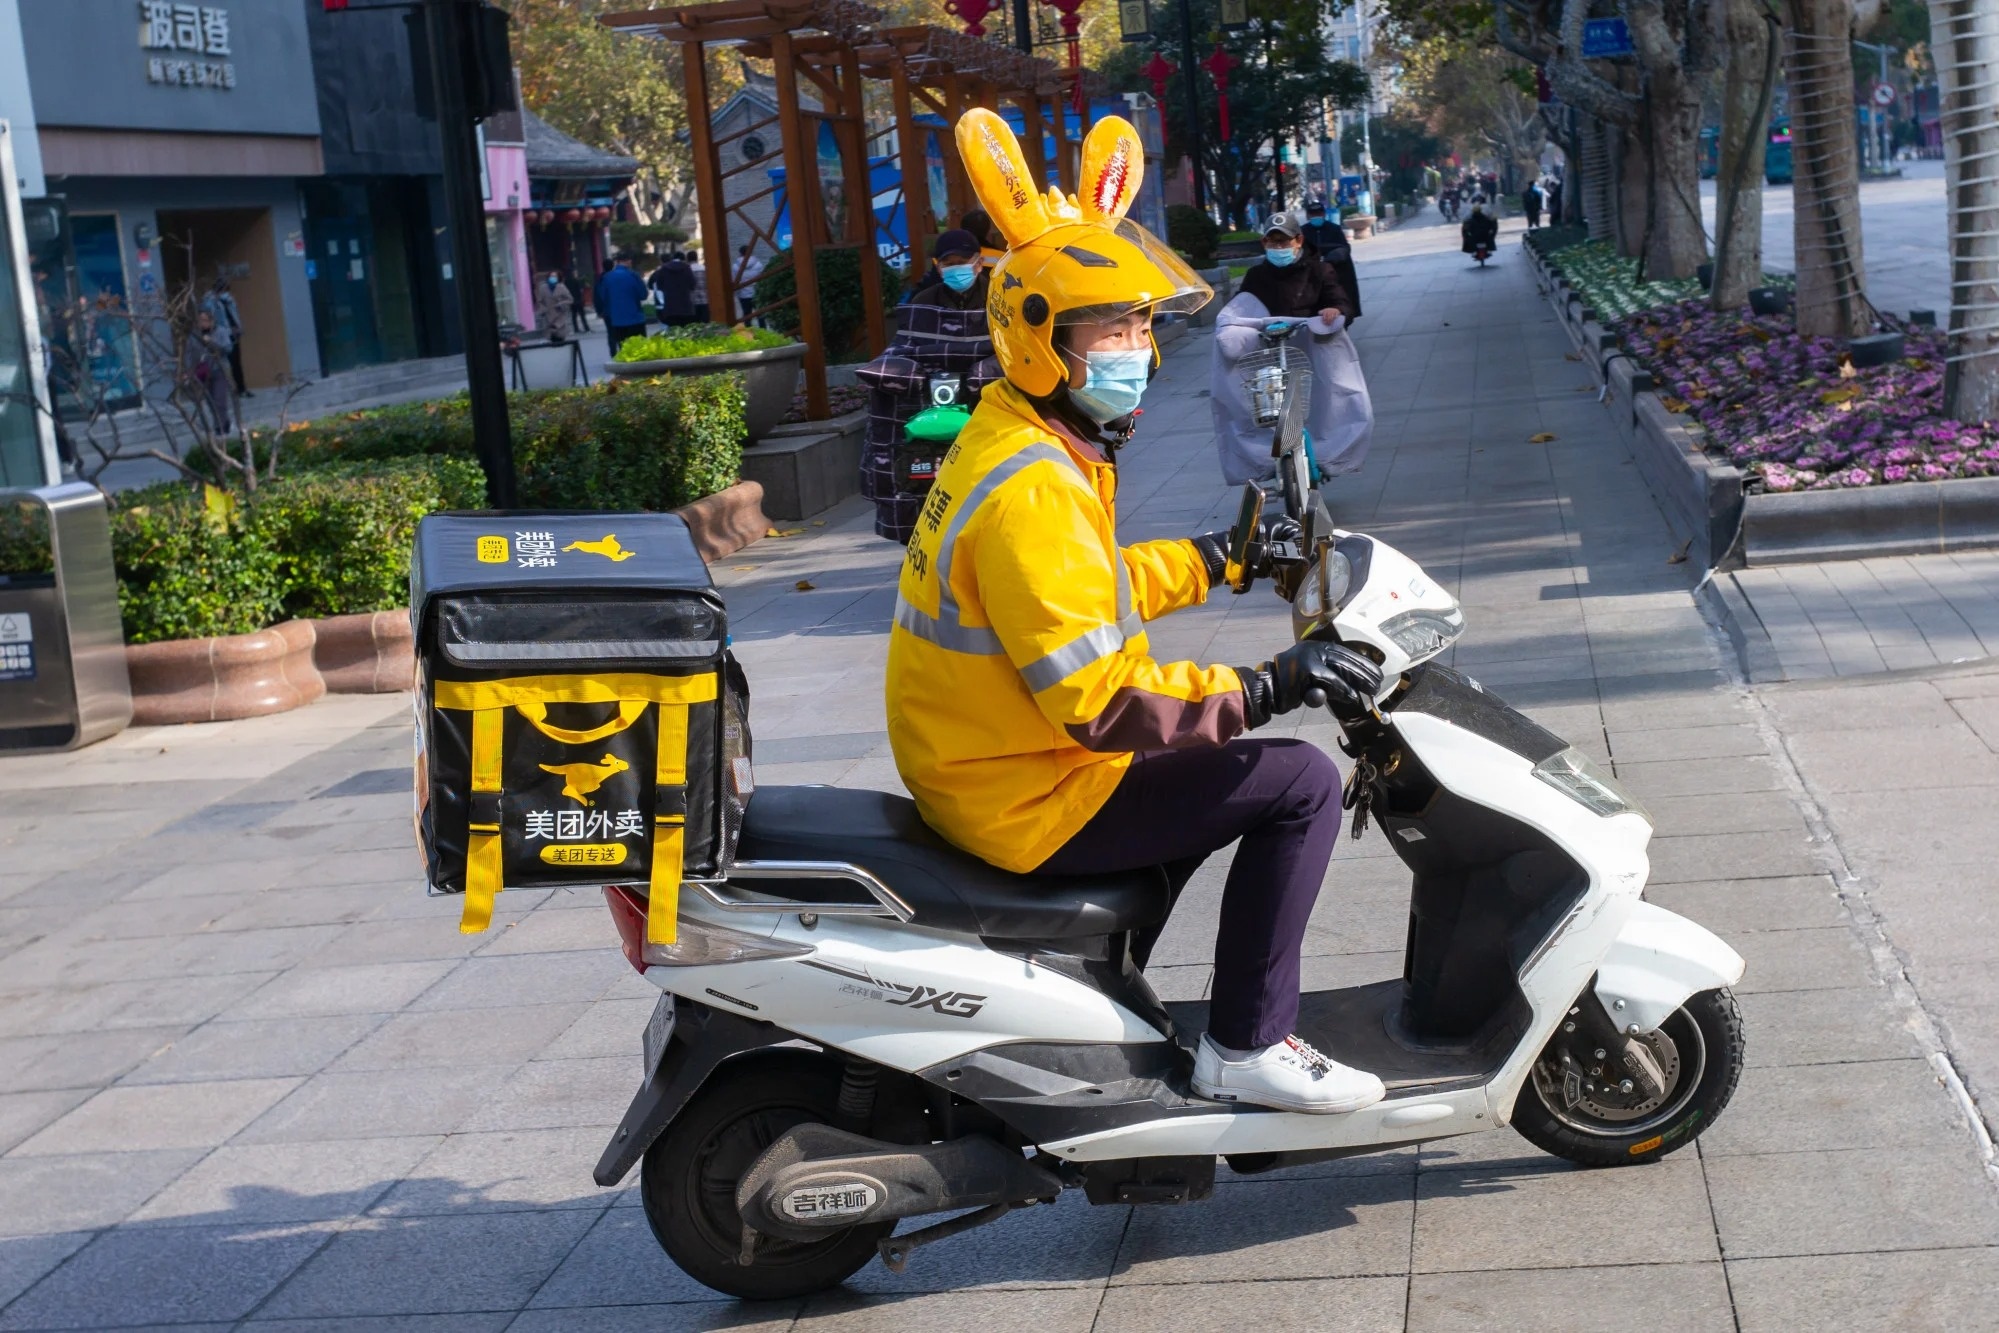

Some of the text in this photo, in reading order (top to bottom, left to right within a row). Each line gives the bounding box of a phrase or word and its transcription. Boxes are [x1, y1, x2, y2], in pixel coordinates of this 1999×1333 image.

[140, 0, 231, 55] 波司登
[515, 531, 558, 568] 美团外卖
[525, 809, 644, 840] 美团外卖
[552, 847, 616, 863] 美团专送
[885, 985, 988, 1019] JXG
